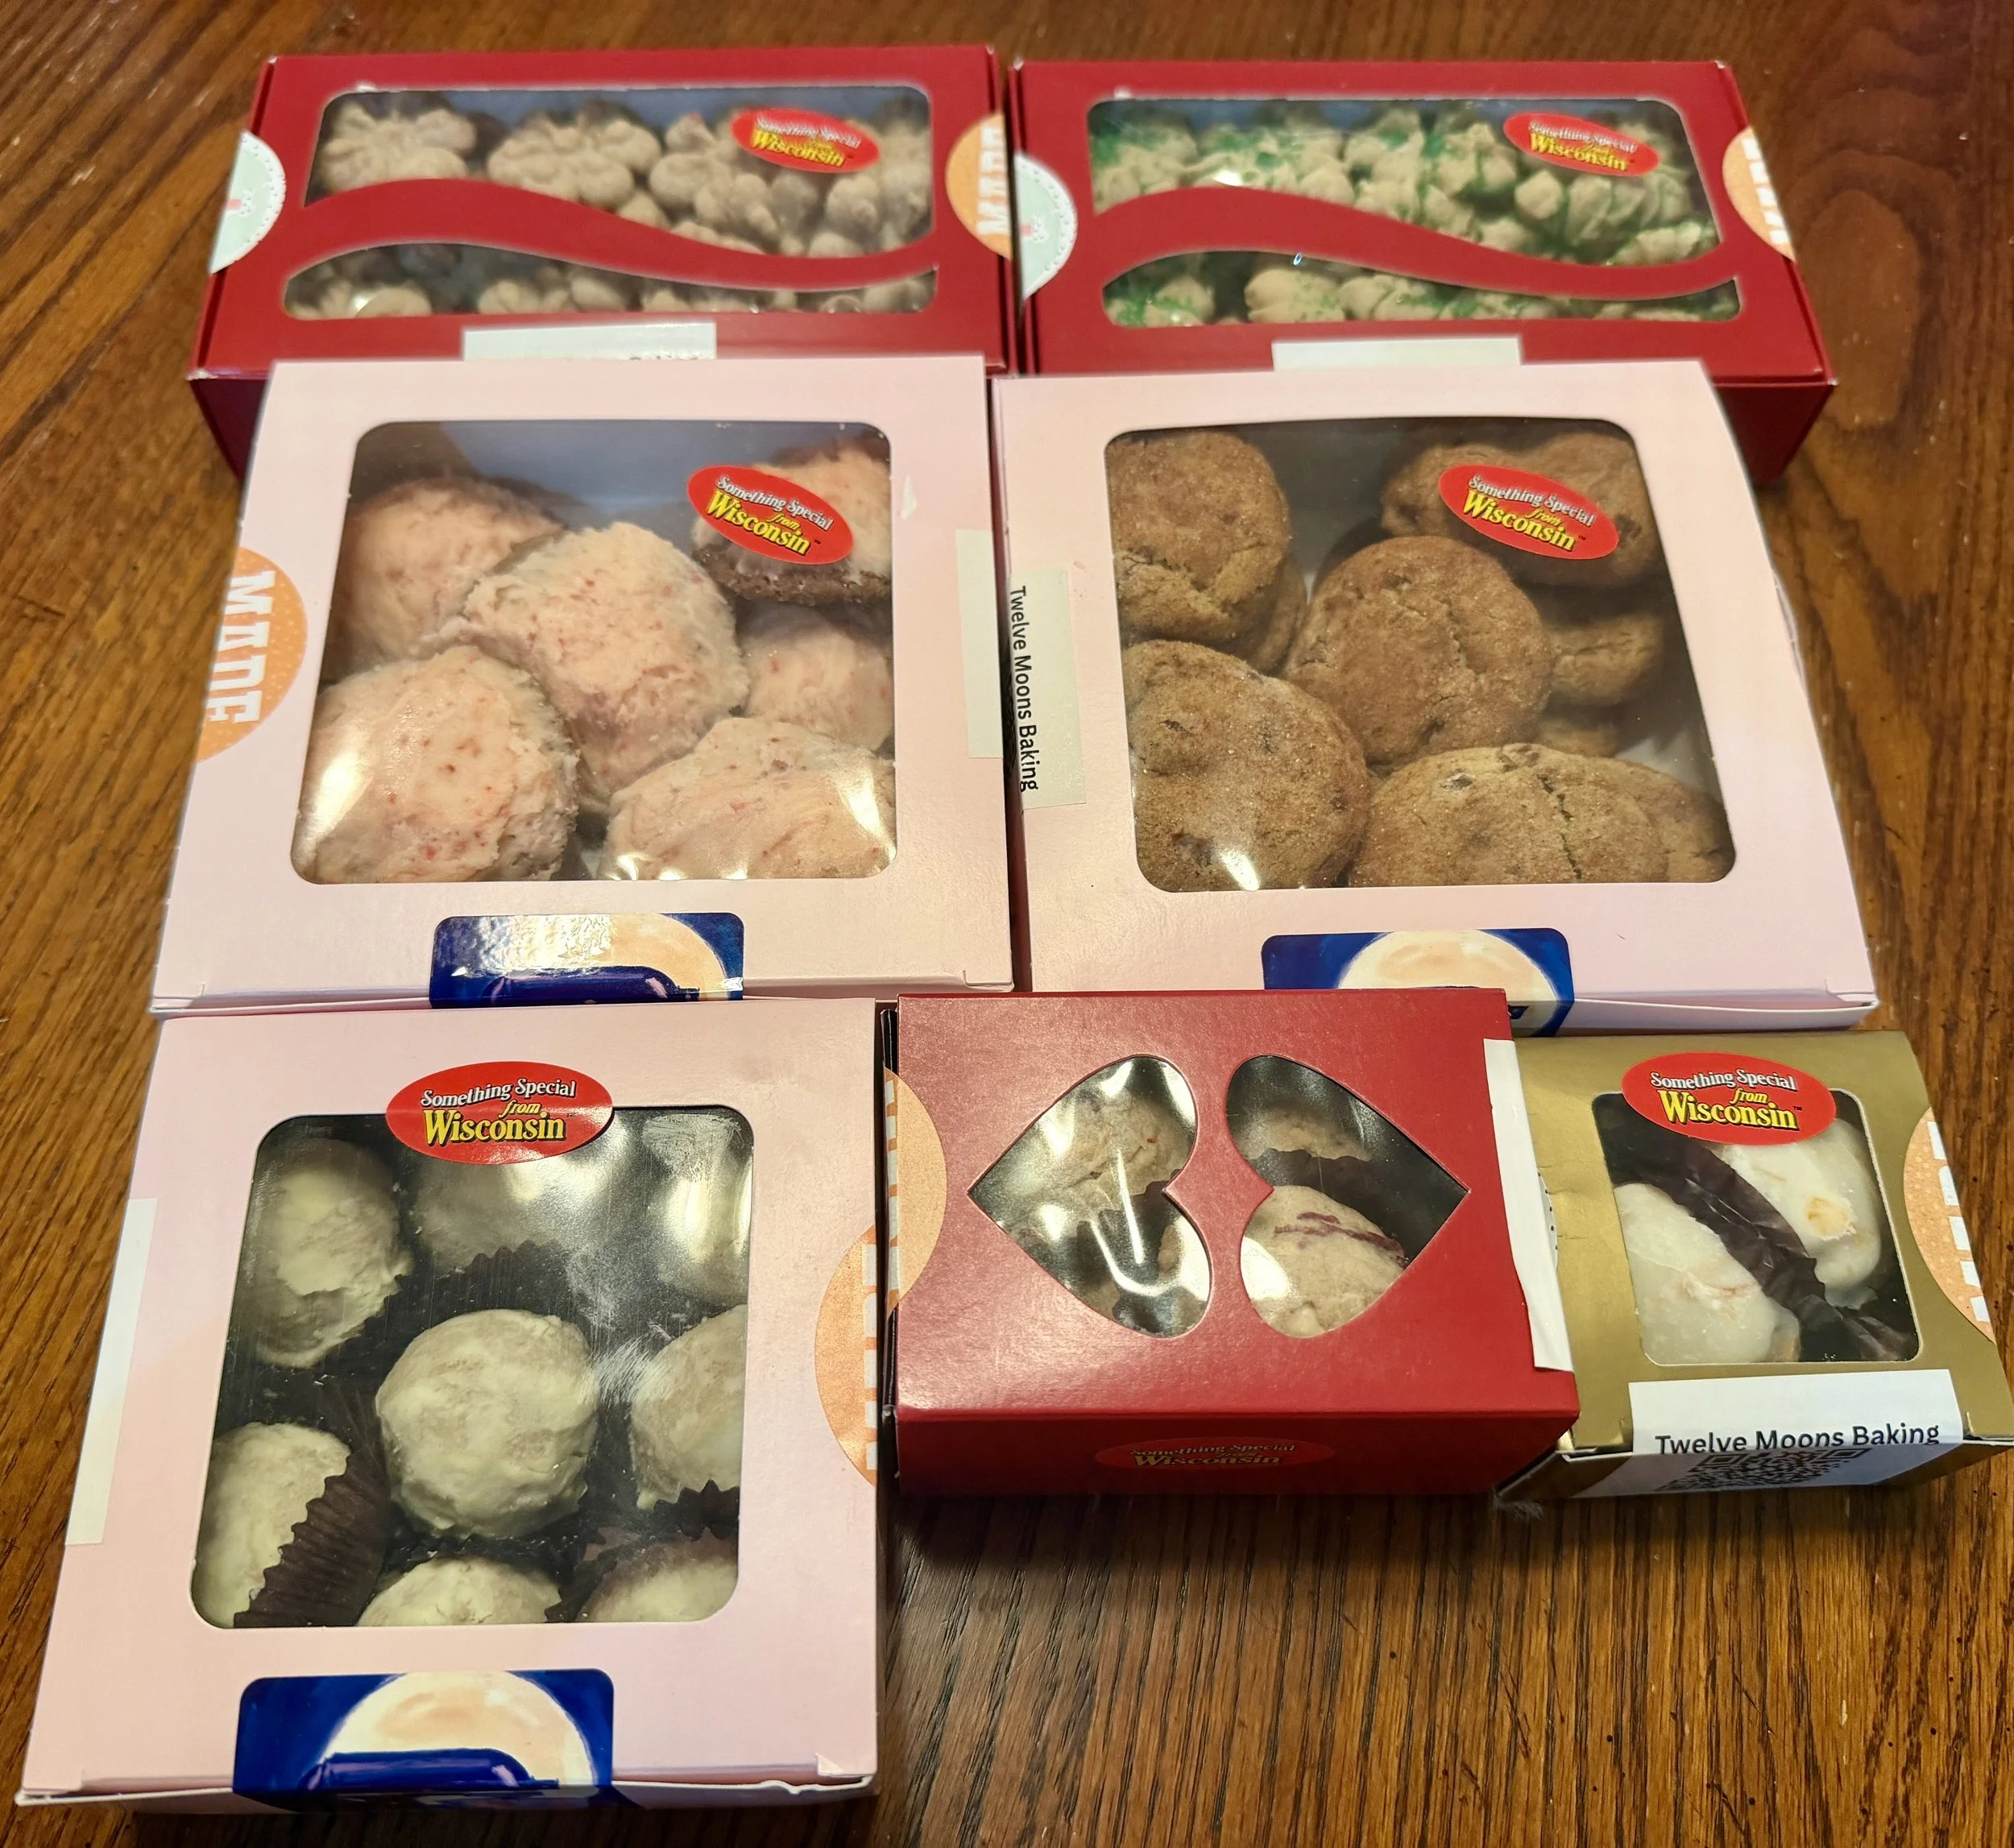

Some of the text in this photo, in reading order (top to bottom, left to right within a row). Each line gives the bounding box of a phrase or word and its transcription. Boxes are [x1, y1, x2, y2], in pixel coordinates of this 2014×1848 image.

[752, 130, 845, 168] Wisconsin
[1529, 122, 1637, 153] Something Special
[1531, 132, 1628, 172] Wisconsin
[717, 476, 834, 531] Something Special
[1469, 474, 1596, 528] Something Special
[707, 489, 811, 556] Wisconsin
[767, 514, 800, 530] from
[1463, 489, 1576, 552] Wisconsin
[1525, 508, 1561, 526] from
[1010, 586, 1040, 793] Twelve Moons Baking
[421, 1078, 577, 1108] Something Special
[1650, 1069, 1797, 1092] Something Special
[1730, 1088, 1769, 1104] from
[500, 1100, 542, 1117] from
[1656, 1090, 1800, 1130] Wisconsin
[423, 1109, 566, 1147] Wisconsin
[1130, 1444, 1295, 1456] Something Special
[1655, 1423, 1940, 1454] Twelve Moons Baking
[1134, 1453, 1283, 1468] Wisconsin
